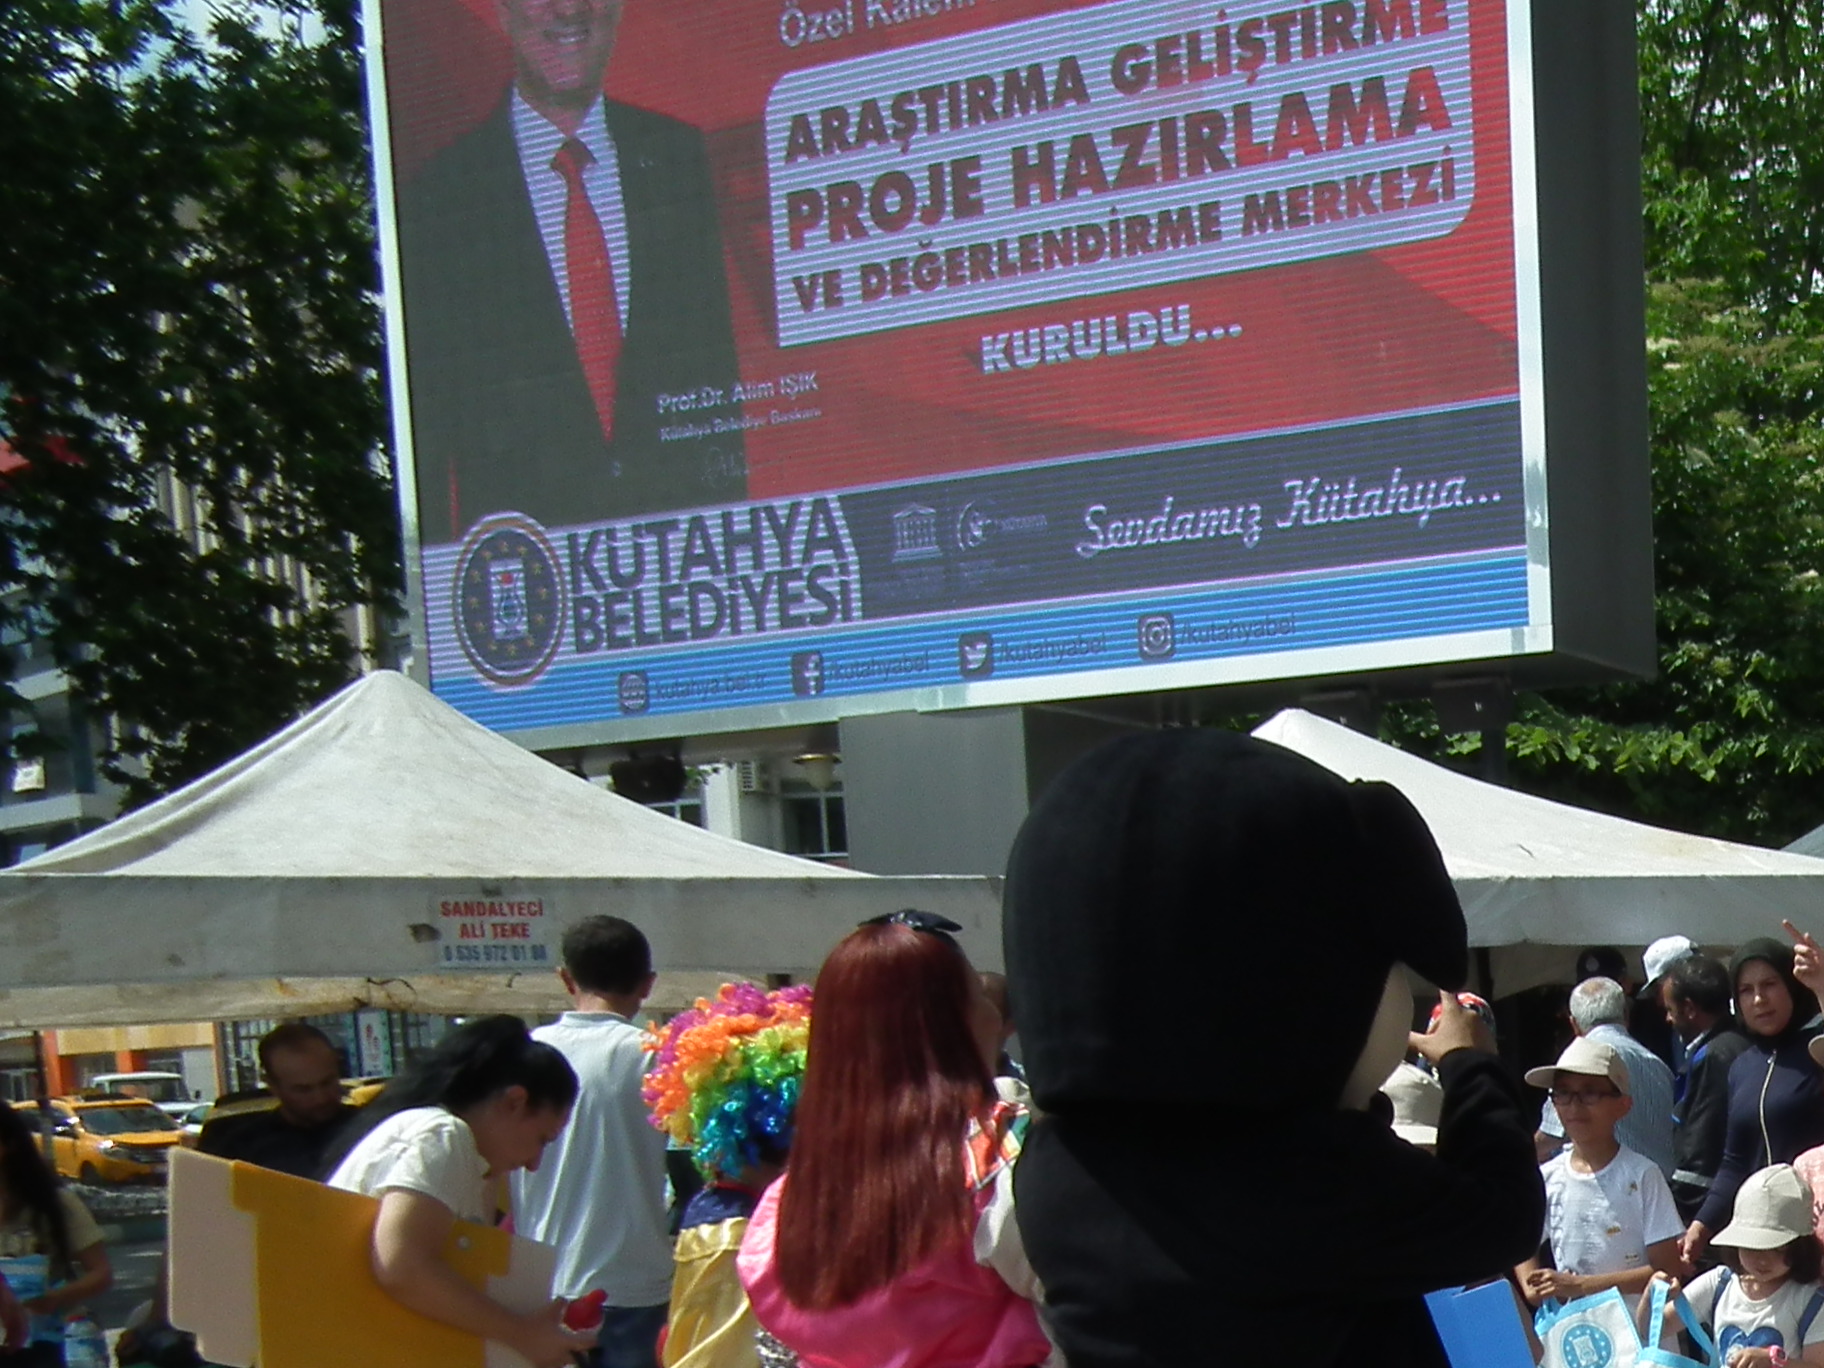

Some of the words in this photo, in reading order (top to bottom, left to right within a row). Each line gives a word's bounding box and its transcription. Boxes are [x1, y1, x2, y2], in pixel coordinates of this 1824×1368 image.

[777, 0, 855, 48] Özel
[783, 55, 1091, 164] ARAŞTIRMA
[1109, 0, 1450, 96] GELİŞTİRME
[788, 155, 985, 251] PROJE
[1010, 66, 1453, 209] HAZIRLAMA
[790, 270, 844, 314] VE
[860, 200, 1222, 291] DEĞERLENDİRME
[1241, 145, 1456, 237] MERKEZİ
[980, 303, 1243, 376] KURULDU...
[567, 495, 849, 598] KÜTAHYA
[1076, 496, 1263, 558] Sevdamız
[570, 557, 863, 654] BELEDİYESİ
[440, 897, 545, 917] SANDALYECİ
[459, 920, 486, 939] ALİ
[490, 921, 531, 940] TEKE
